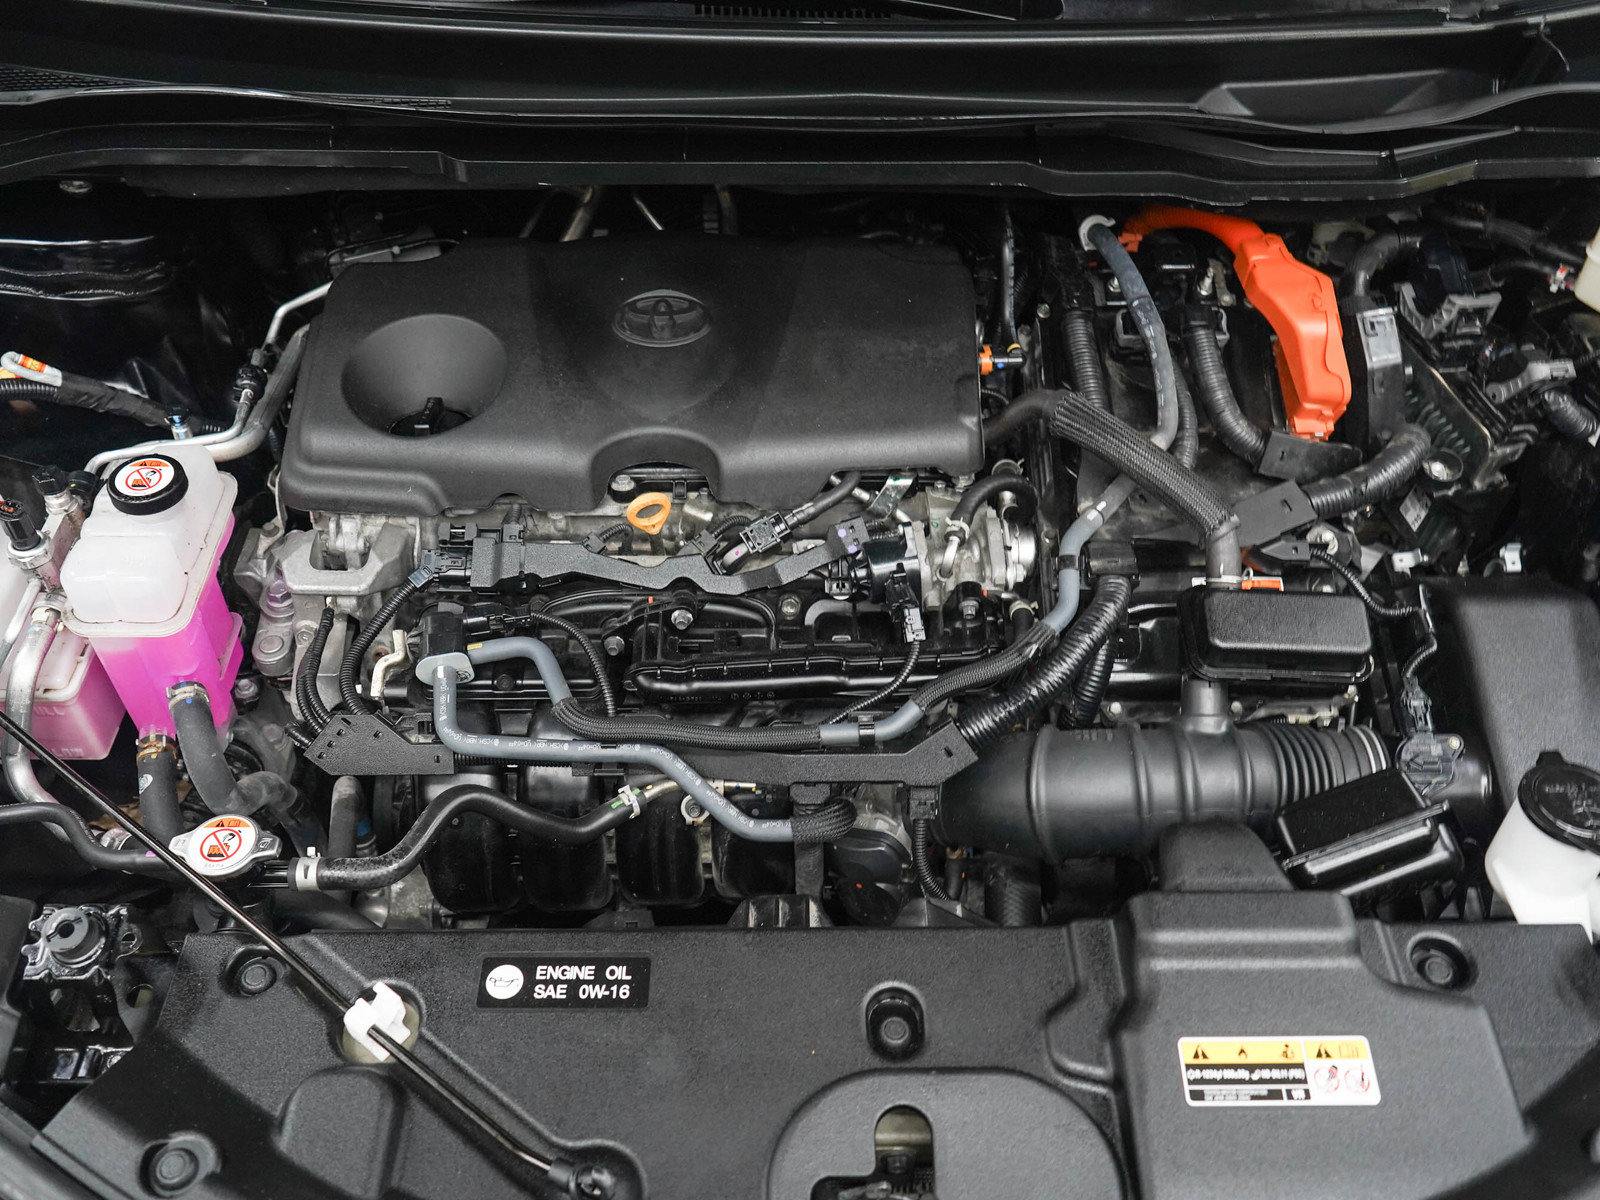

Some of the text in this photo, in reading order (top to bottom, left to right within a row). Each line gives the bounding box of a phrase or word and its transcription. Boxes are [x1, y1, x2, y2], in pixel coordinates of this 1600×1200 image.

[535, 965, 632, 980] ENGINE OIL
[533, 984, 630, 999] SAE 0W-16
